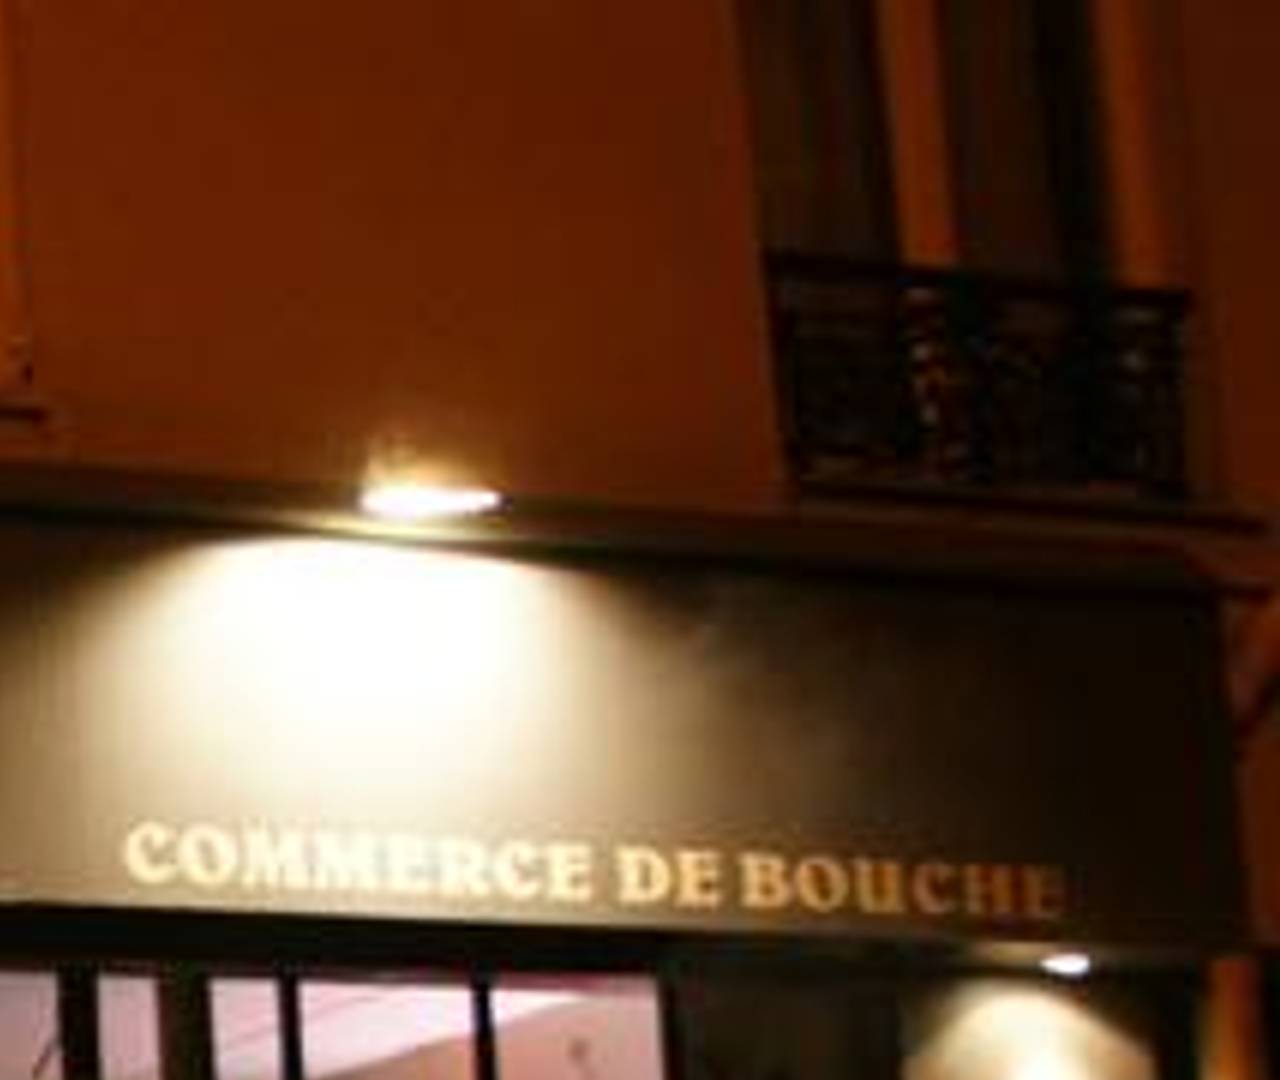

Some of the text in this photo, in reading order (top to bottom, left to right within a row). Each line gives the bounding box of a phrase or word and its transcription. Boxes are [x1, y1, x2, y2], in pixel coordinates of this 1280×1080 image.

[124, 821, 1067, 918] COMMERCE DE BOUCHE
